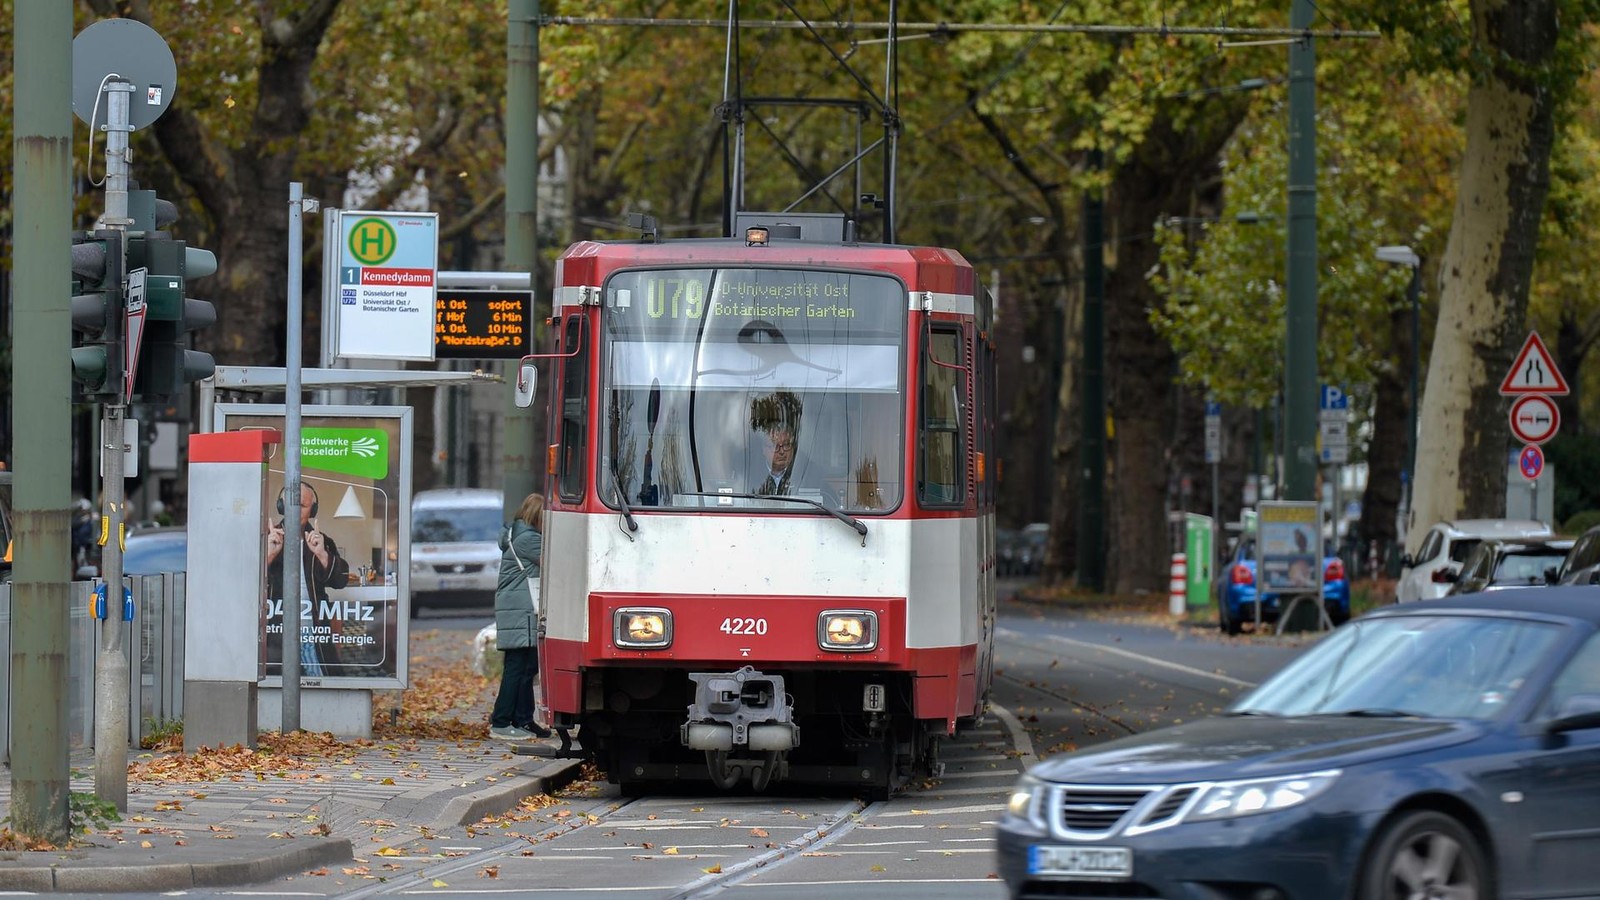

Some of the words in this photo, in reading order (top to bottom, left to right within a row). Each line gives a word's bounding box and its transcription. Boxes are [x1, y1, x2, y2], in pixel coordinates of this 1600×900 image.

[361, 227, 385, 256] H
[347, 268, 354, 283] 1
[363, 271, 431, 285] Kennedydamm
[363, 289, 395, 297] Düsseldorf
[396, 290, 407, 298] Hbf
[721, 281, 818, 298] D-Universität
[824, 283, 849, 297] Ost
[647, 278, 703, 319] U79
[362, 305, 397, 313] Botanischer
[398, 305, 419, 313] Garten
[449, 299, 467, 310] Ost
[487, 299, 522, 312] sofort
[714, 302, 801, 316] Botanischer
[806, 303, 855, 318] Garten
[446, 311, 466, 324] Hbf
[492, 311, 501, 322] 6
[502, 311, 522, 322] Min
[449, 323, 467, 334] Ost
[487, 323, 501, 334] 10
[502, 323, 522, 334] Min
[301, 437, 349, 446] tadtwerke
[301, 447, 349, 456] üsseldorf
[318, 600, 375, 622] MHz
[311, 625, 331, 634] von
[719, 617, 768, 636] 4220
[300, 634, 329, 643] serer
[332, 634, 376, 646] Energie.
